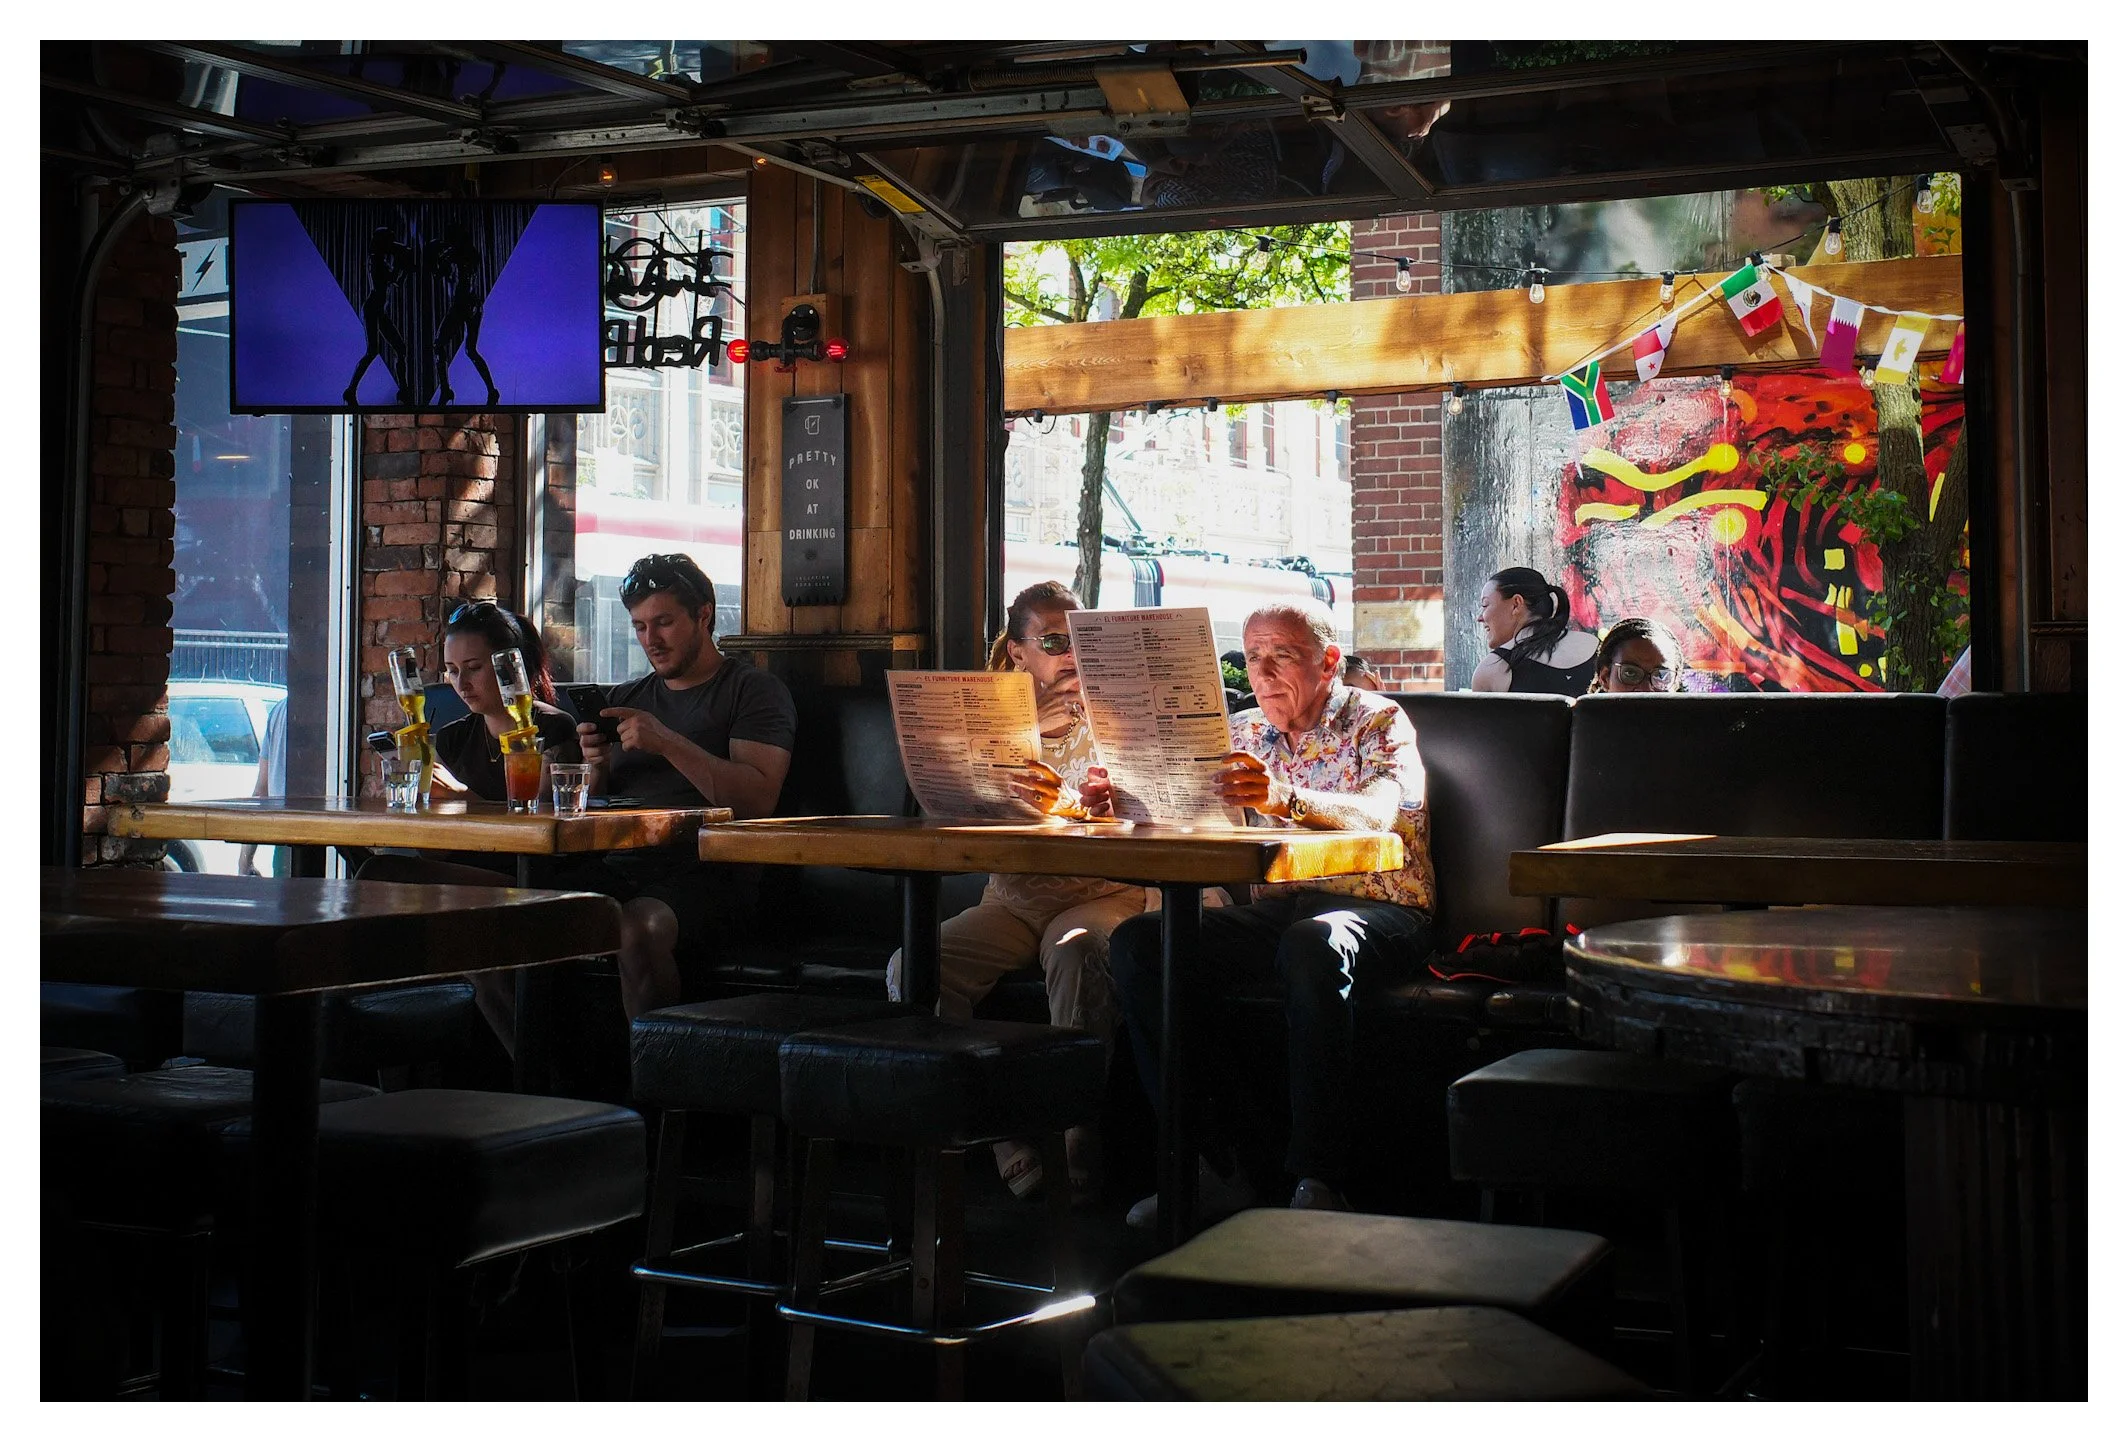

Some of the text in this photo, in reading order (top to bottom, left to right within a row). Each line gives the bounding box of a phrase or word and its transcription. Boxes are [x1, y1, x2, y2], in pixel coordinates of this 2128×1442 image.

[788, 450, 837, 470] PRETTY
[805, 478, 819, 490] OK
[806, 503, 819, 515] AT
[789, 528, 836, 540] DRINKING
[1112, 614, 1140, 623] FURNITURE
[1141, 613, 1173, 621] WAREHOUSE
